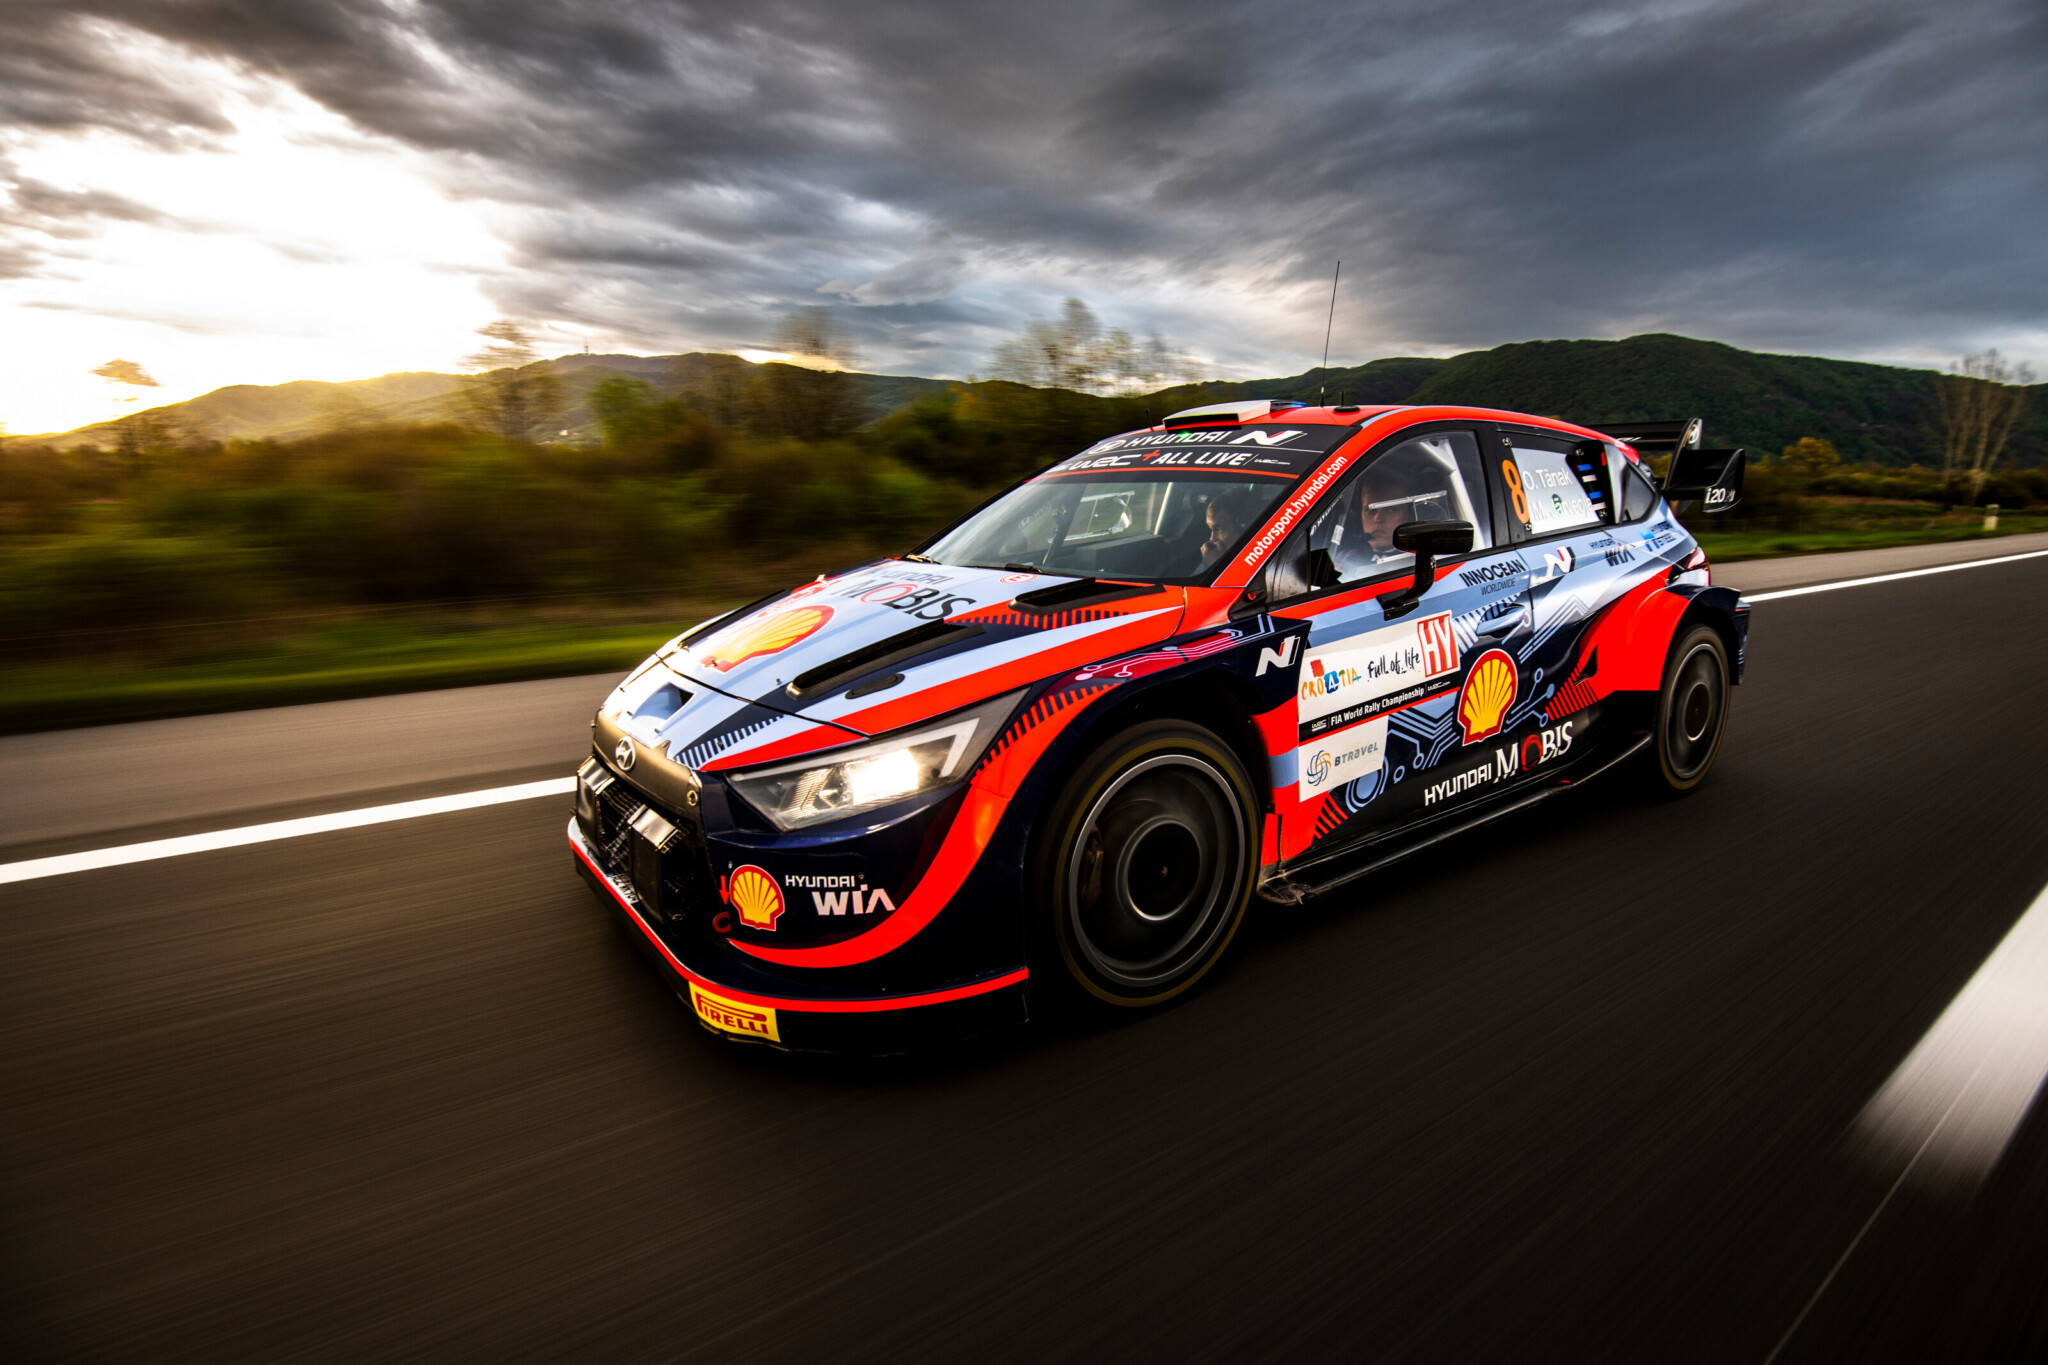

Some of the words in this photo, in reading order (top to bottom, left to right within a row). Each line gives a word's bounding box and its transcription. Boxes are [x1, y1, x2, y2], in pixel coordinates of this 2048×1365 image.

[1123, 431, 1232, 448] HYUNDAI
[1148, 452, 1194, 466] ALL
[1195, 452, 1252, 466] LIVE
[1502, 459, 1530, 523] 8
[1522, 470, 1539, 490] O.
[1535, 467, 1573, 488] Tänak
[1244, 456, 1348, 566] motorsport.hyundai.com
[1530, 500, 1548, 521] M.
[1705, 487, 1726, 504] i20
[1459, 558, 1526, 587] INNOCEAN
[1481, 578, 1516, 595] WORLDWIDE
[831, 580, 977, 620] MOBIS
[1255, 635, 1301, 677] N
[1418, 615, 1455, 677] HY
[1367, 655, 1389, 678] Full
[1404, 647, 1420, 670] life
[1301, 666, 1362, 700] CROATIA
[1330, 714, 1343, 726] FIA
[1343, 708, 1363, 722] World
[1364, 701, 1381, 715] Rally
[1381, 687, 1425, 708] Championship
[1424, 762, 1492, 806] HYUNDAI
[1493, 721, 1573, 784] MOBIS
[785, 875, 855, 888] HYUNDAI
[811, 884, 896, 916] WIA
[695, 991, 769, 1034] PIRELLI
